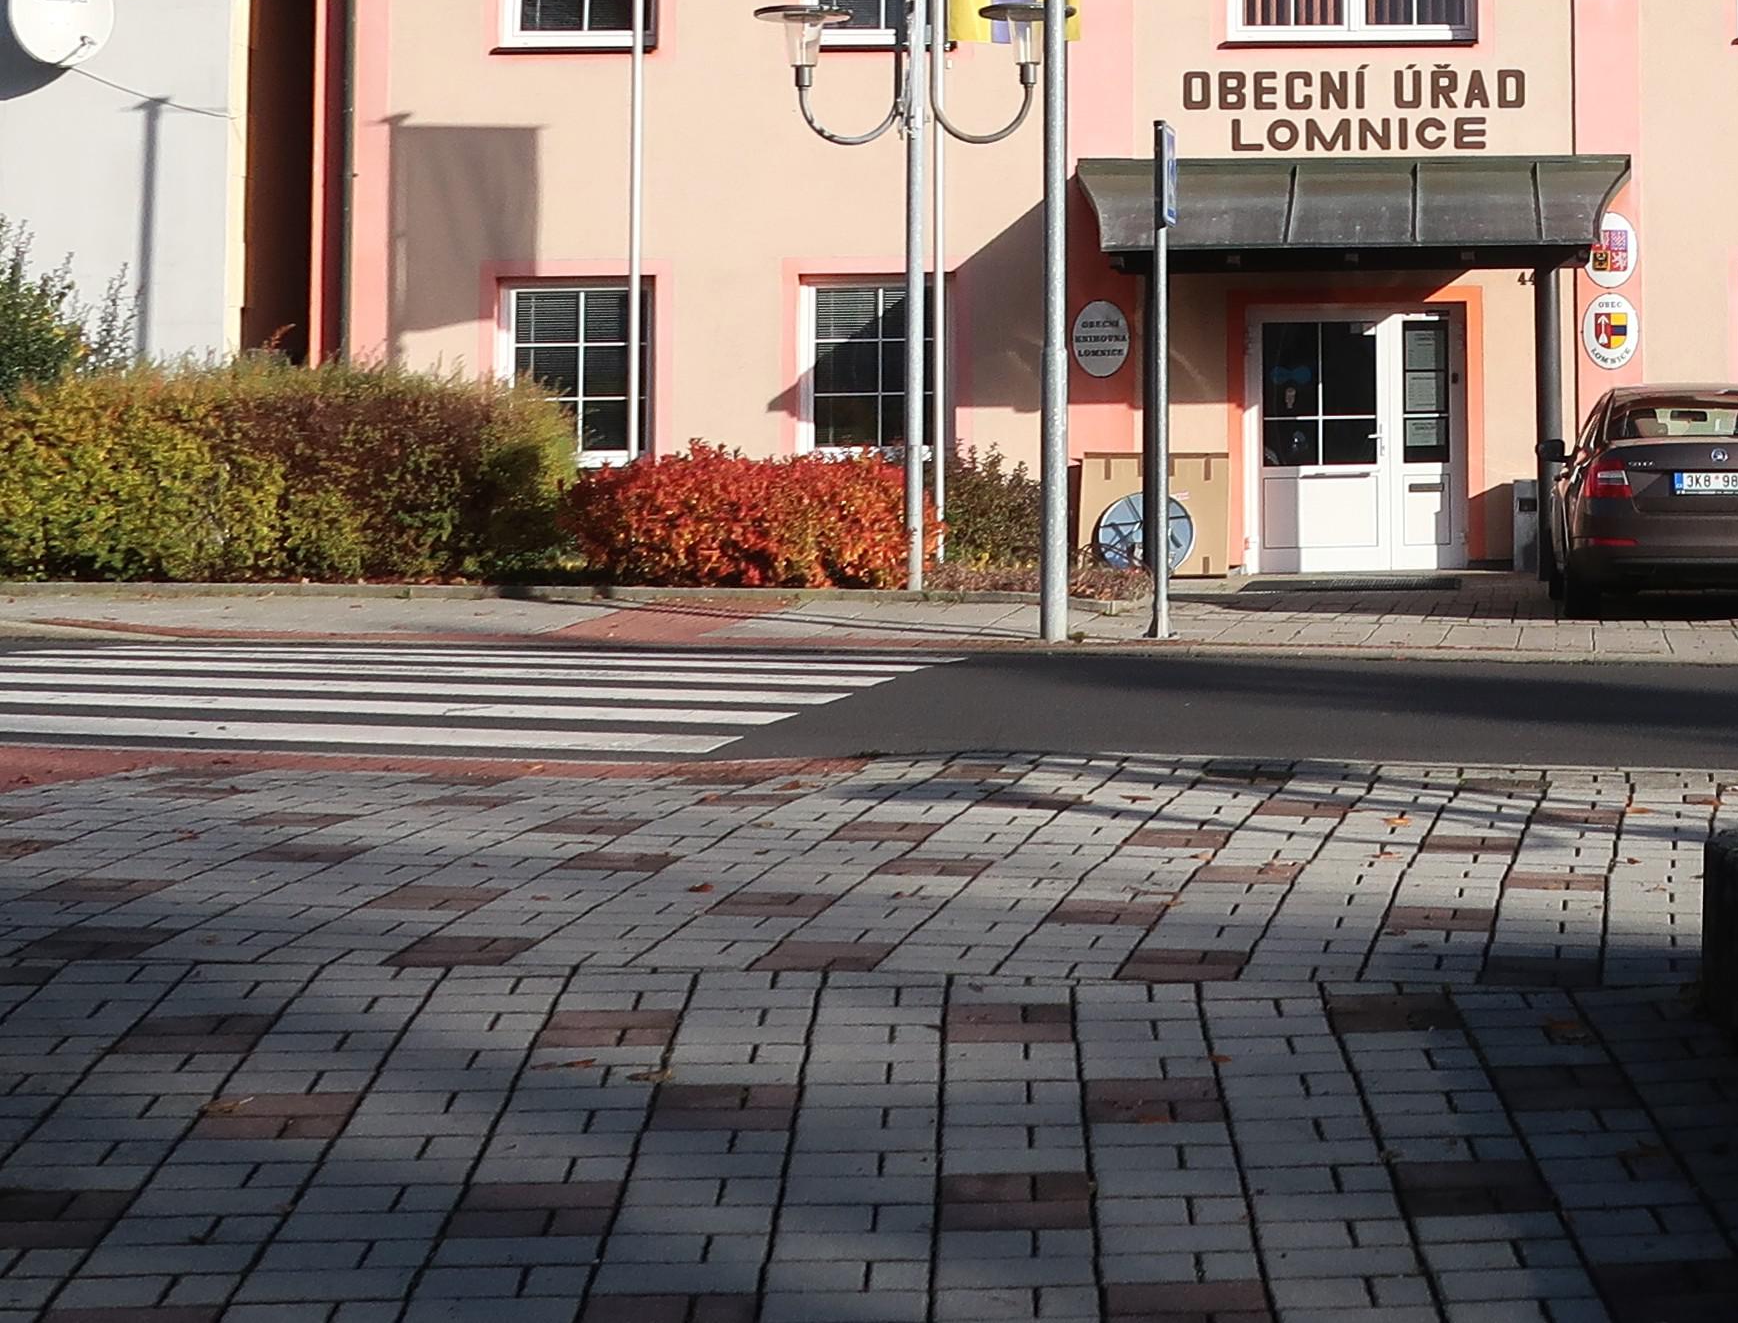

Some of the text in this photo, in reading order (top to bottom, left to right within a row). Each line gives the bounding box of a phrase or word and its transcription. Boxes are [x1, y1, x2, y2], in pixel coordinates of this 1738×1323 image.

[1182, 63, 1526, 110] OBECNÍ ÚŘAD
[1231, 117, 1487, 151] LOMNICE
[1687, 475, 1711, 488] 3K8
